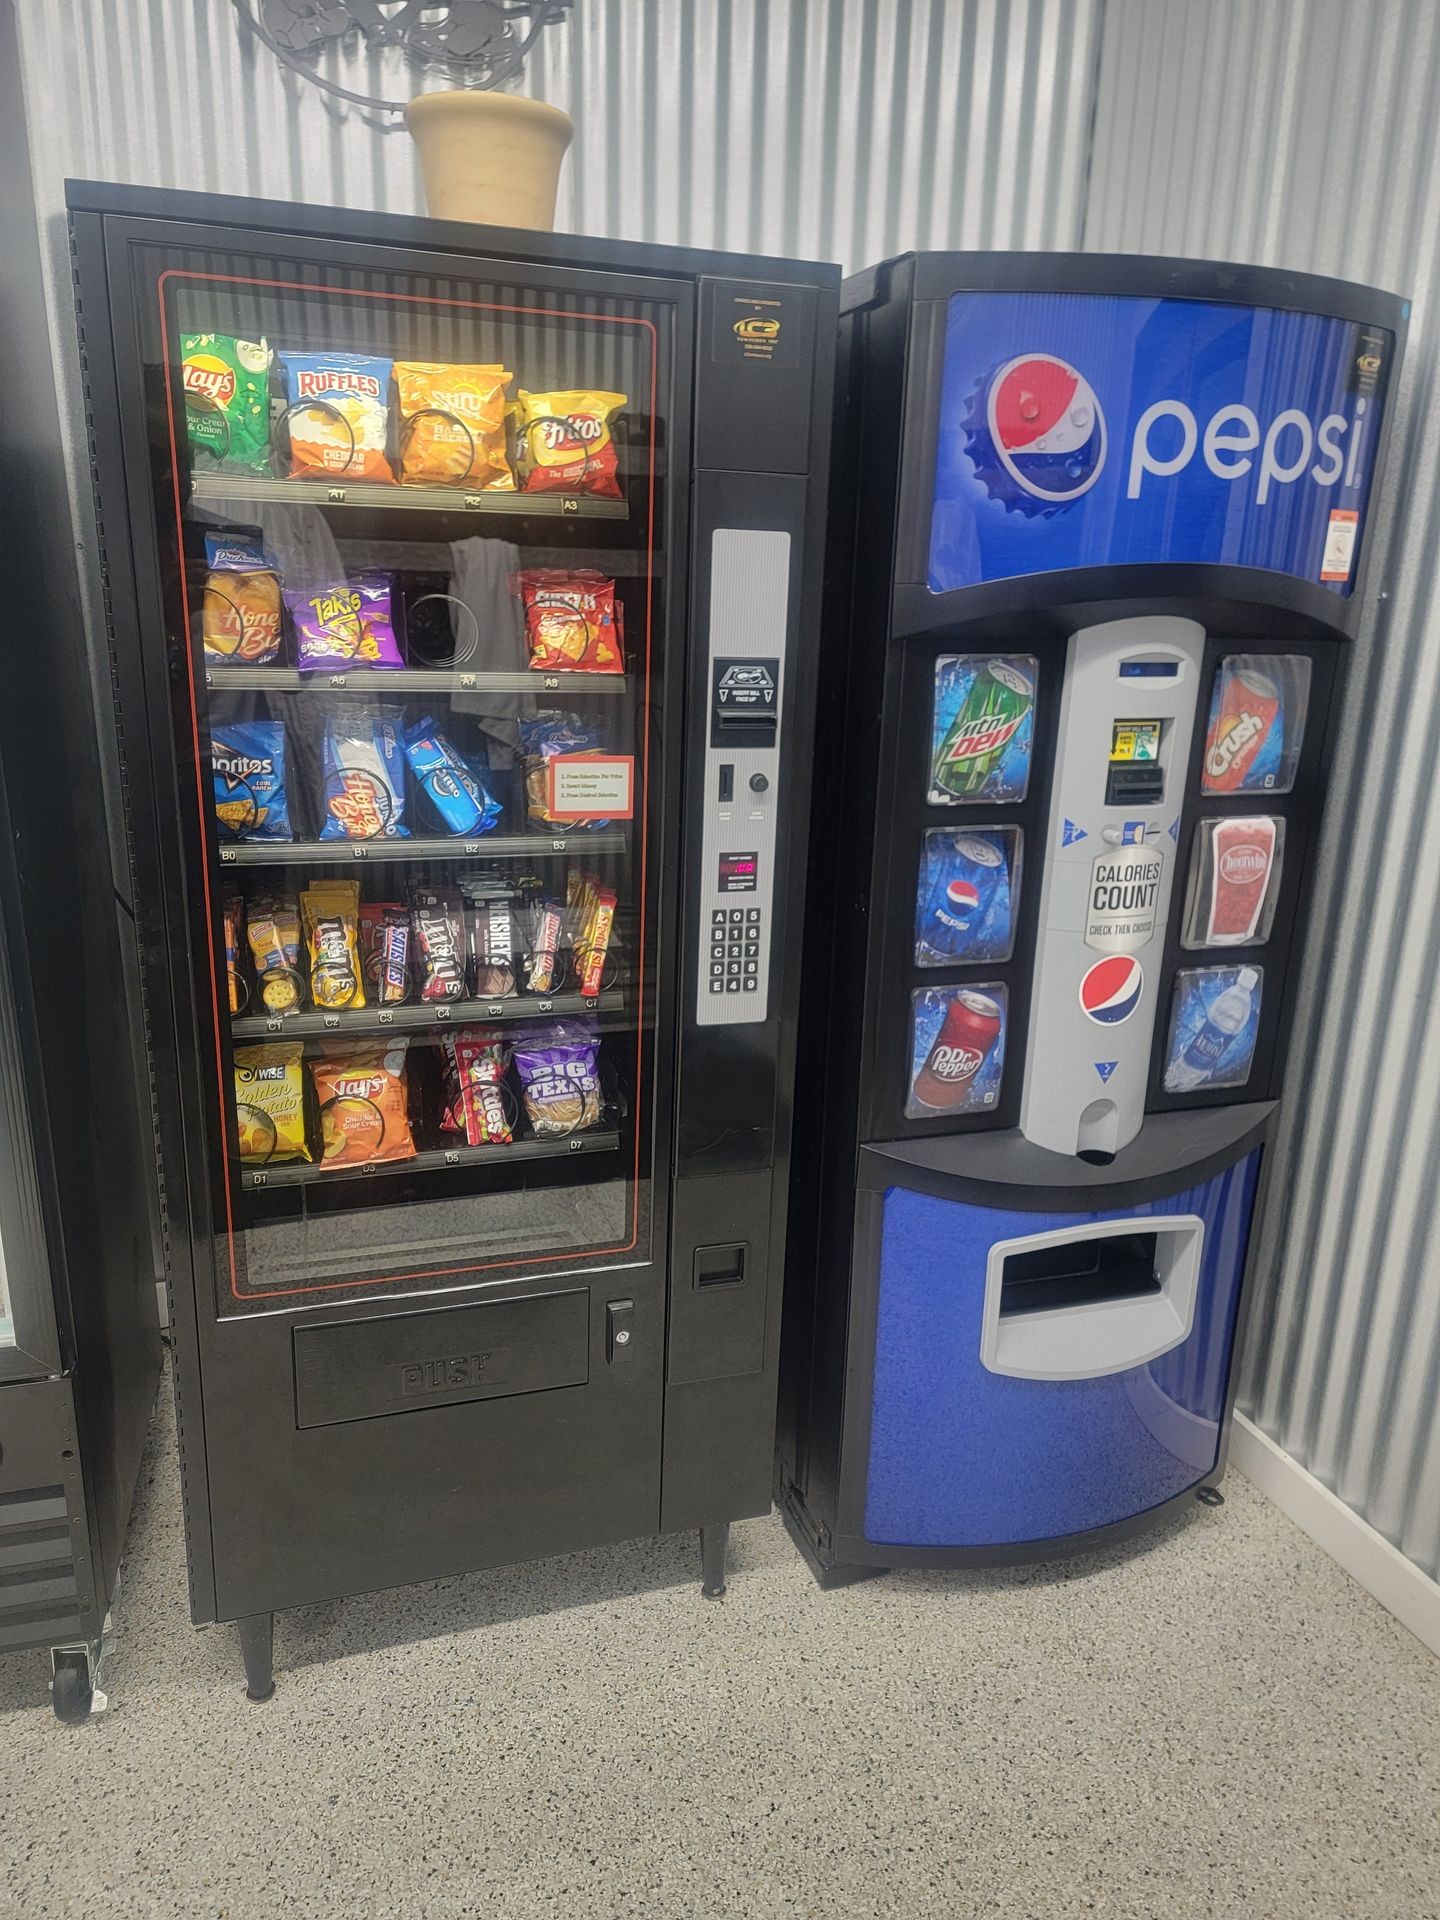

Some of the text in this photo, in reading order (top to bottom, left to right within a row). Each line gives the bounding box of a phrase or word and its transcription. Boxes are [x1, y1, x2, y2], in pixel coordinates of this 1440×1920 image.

[183, 365, 233, 398] Lay's
[297, 371, 380, 397] RUFFLES
[186, 415, 201, 424] our
[187, 423, 223, 434] & Onion
[542, 415, 603, 449] Fritos
[1127, 397, 1366, 505] pepsi
[549, 470, 562, 478] The
[329, 489, 345, 499] A1
[465, 496, 481, 506] A2
[564, 500, 578, 510] A3
[308, 587, 362, 627] Takis
[331, 676, 346, 685] A6
[460, 676, 476, 686] A7
[545, 678, 559, 688] A8
[957, 716, 1002, 739] Mtn
[1206, 711, 1264, 778] Crush
[435, 767, 460, 798] OREO
[345, 773, 380, 835] Honey
[330, 795, 364, 837] Bun
[465, 843, 478, 853] B2
[553, 841, 566, 850] B3
[222, 851, 236, 860] B0
[354, 847, 367, 857] B1
[1096, 862, 1160, 883] CALORIES
[1093, 882, 1157, 911] COUNT
[715, 911, 757, 922] A 0 5
[935, 908, 970, 931] PEPSI
[489, 900, 512, 966] HERSHEY'S
[1089, 920, 1153, 936] CHECK THEN CHOOSE
[714, 929, 757, 939] B 1 6
[318, 920, 352, 991] m&m's
[714, 946, 756, 957] C 2 7
[424, 924, 461, 994] m&m's
[713, 963, 755, 974] D 3 8
[713, 980, 755, 991] E 4 9
[539, 1002, 552, 1010] C6
[586, 999, 597, 1007] C7
[437, 1009, 450, 1018] C4
[489, 1005, 503, 1014] C5
[325, 1018, 339, 1027] C2
[379, 1014, 393, 1022] C3
[269, 1021, 282, 1030] C1
[932, 1045, 980, 1076] Pepper
[951, 1047, 972, 1063] Dr
[258, 1067, 284, 1080] WISE
[530, 1062, 587, 1080] BIG
[339, 1077, 382, 1099] Lay's
[527, 1077, 595, 1098] TEXAS
[273, 1113, 298, 1122] HONEY
[342, 1121, 360, 1130] Sour
[571, 1141, 582, 1149] D7
[447, 1154, 459, 1162] D5
[254, 1175, 266, 1184] D1
